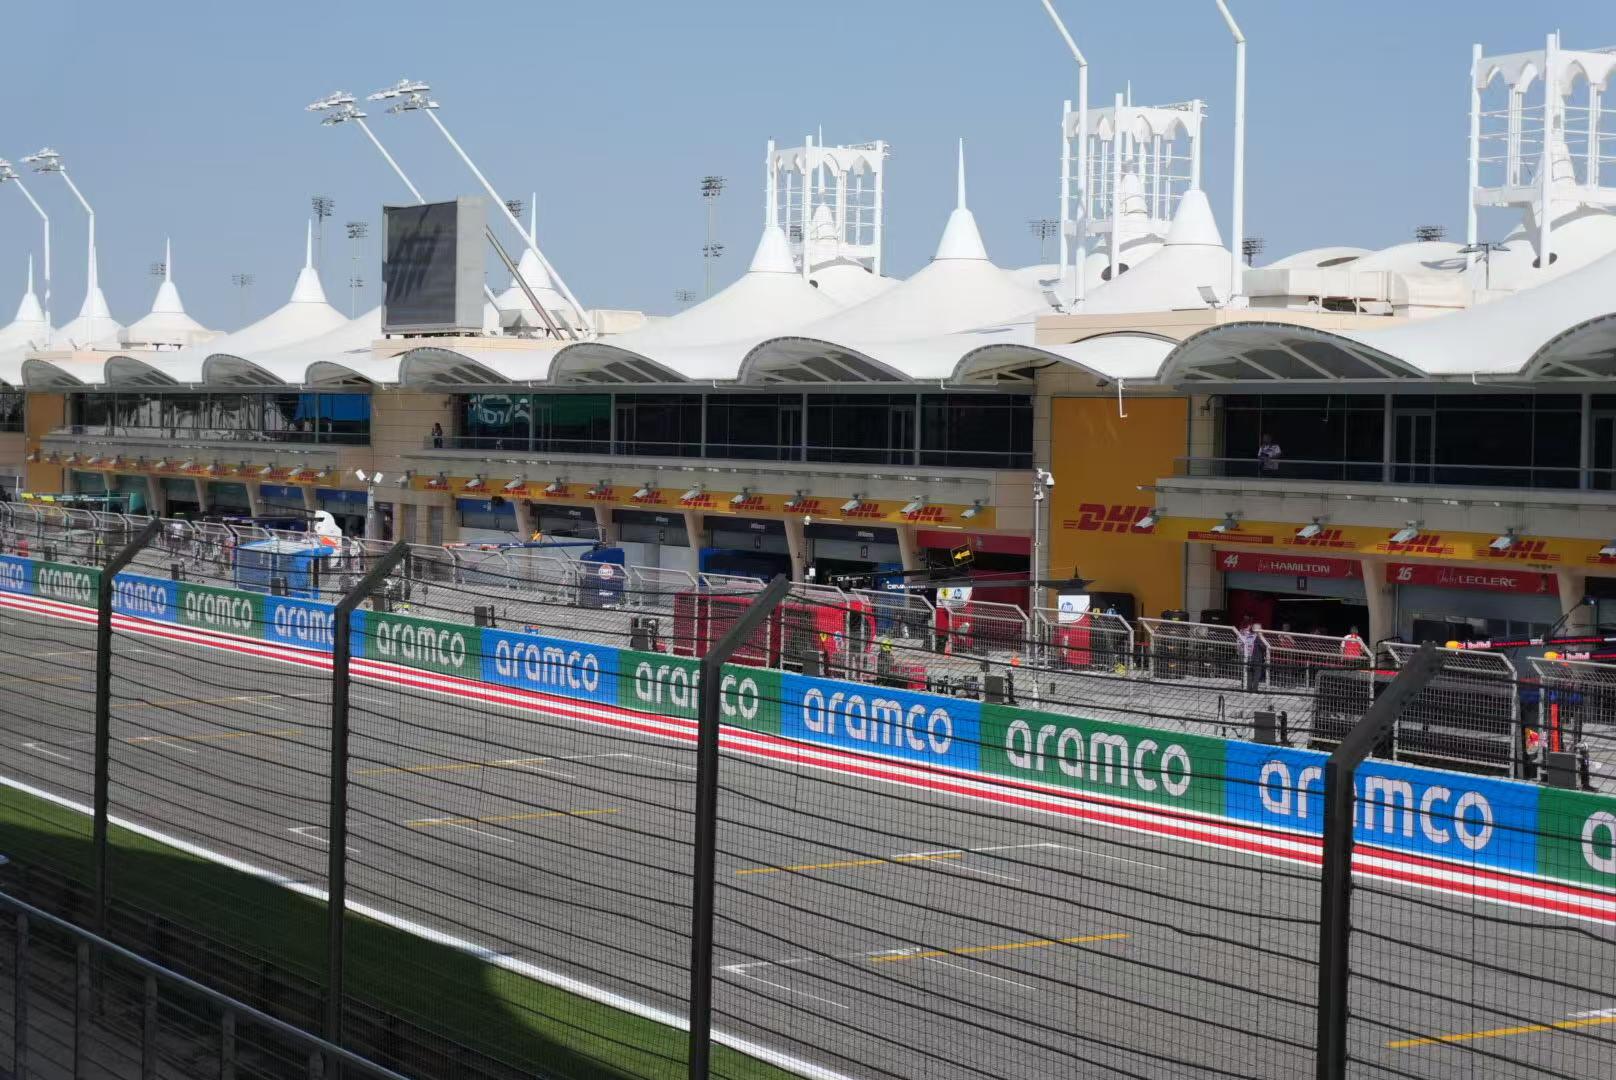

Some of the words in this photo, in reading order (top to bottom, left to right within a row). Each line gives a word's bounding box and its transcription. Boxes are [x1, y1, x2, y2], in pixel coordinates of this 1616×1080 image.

[1079, 503, 1156, 535] DHL
[1223, 554, 1239, 568] 44
[1271, 561, 1330, 574] HAMILTON
[1397, 566, 1412, 581] 16
[1459, 575, 1517, 588] LECLERC
[39, 567, 91, 601] aramco
[186, 590, 252, 631] aramco
[274, 604, 334, 645] aramc
[376, 620, 466, 668] aramco
[495, 639, 599, 692] aramco
[803, 688, 951, 754] aramco
[1005, 719, 1191, 796] aramco
[1259, 760, 1493, 850] armco
